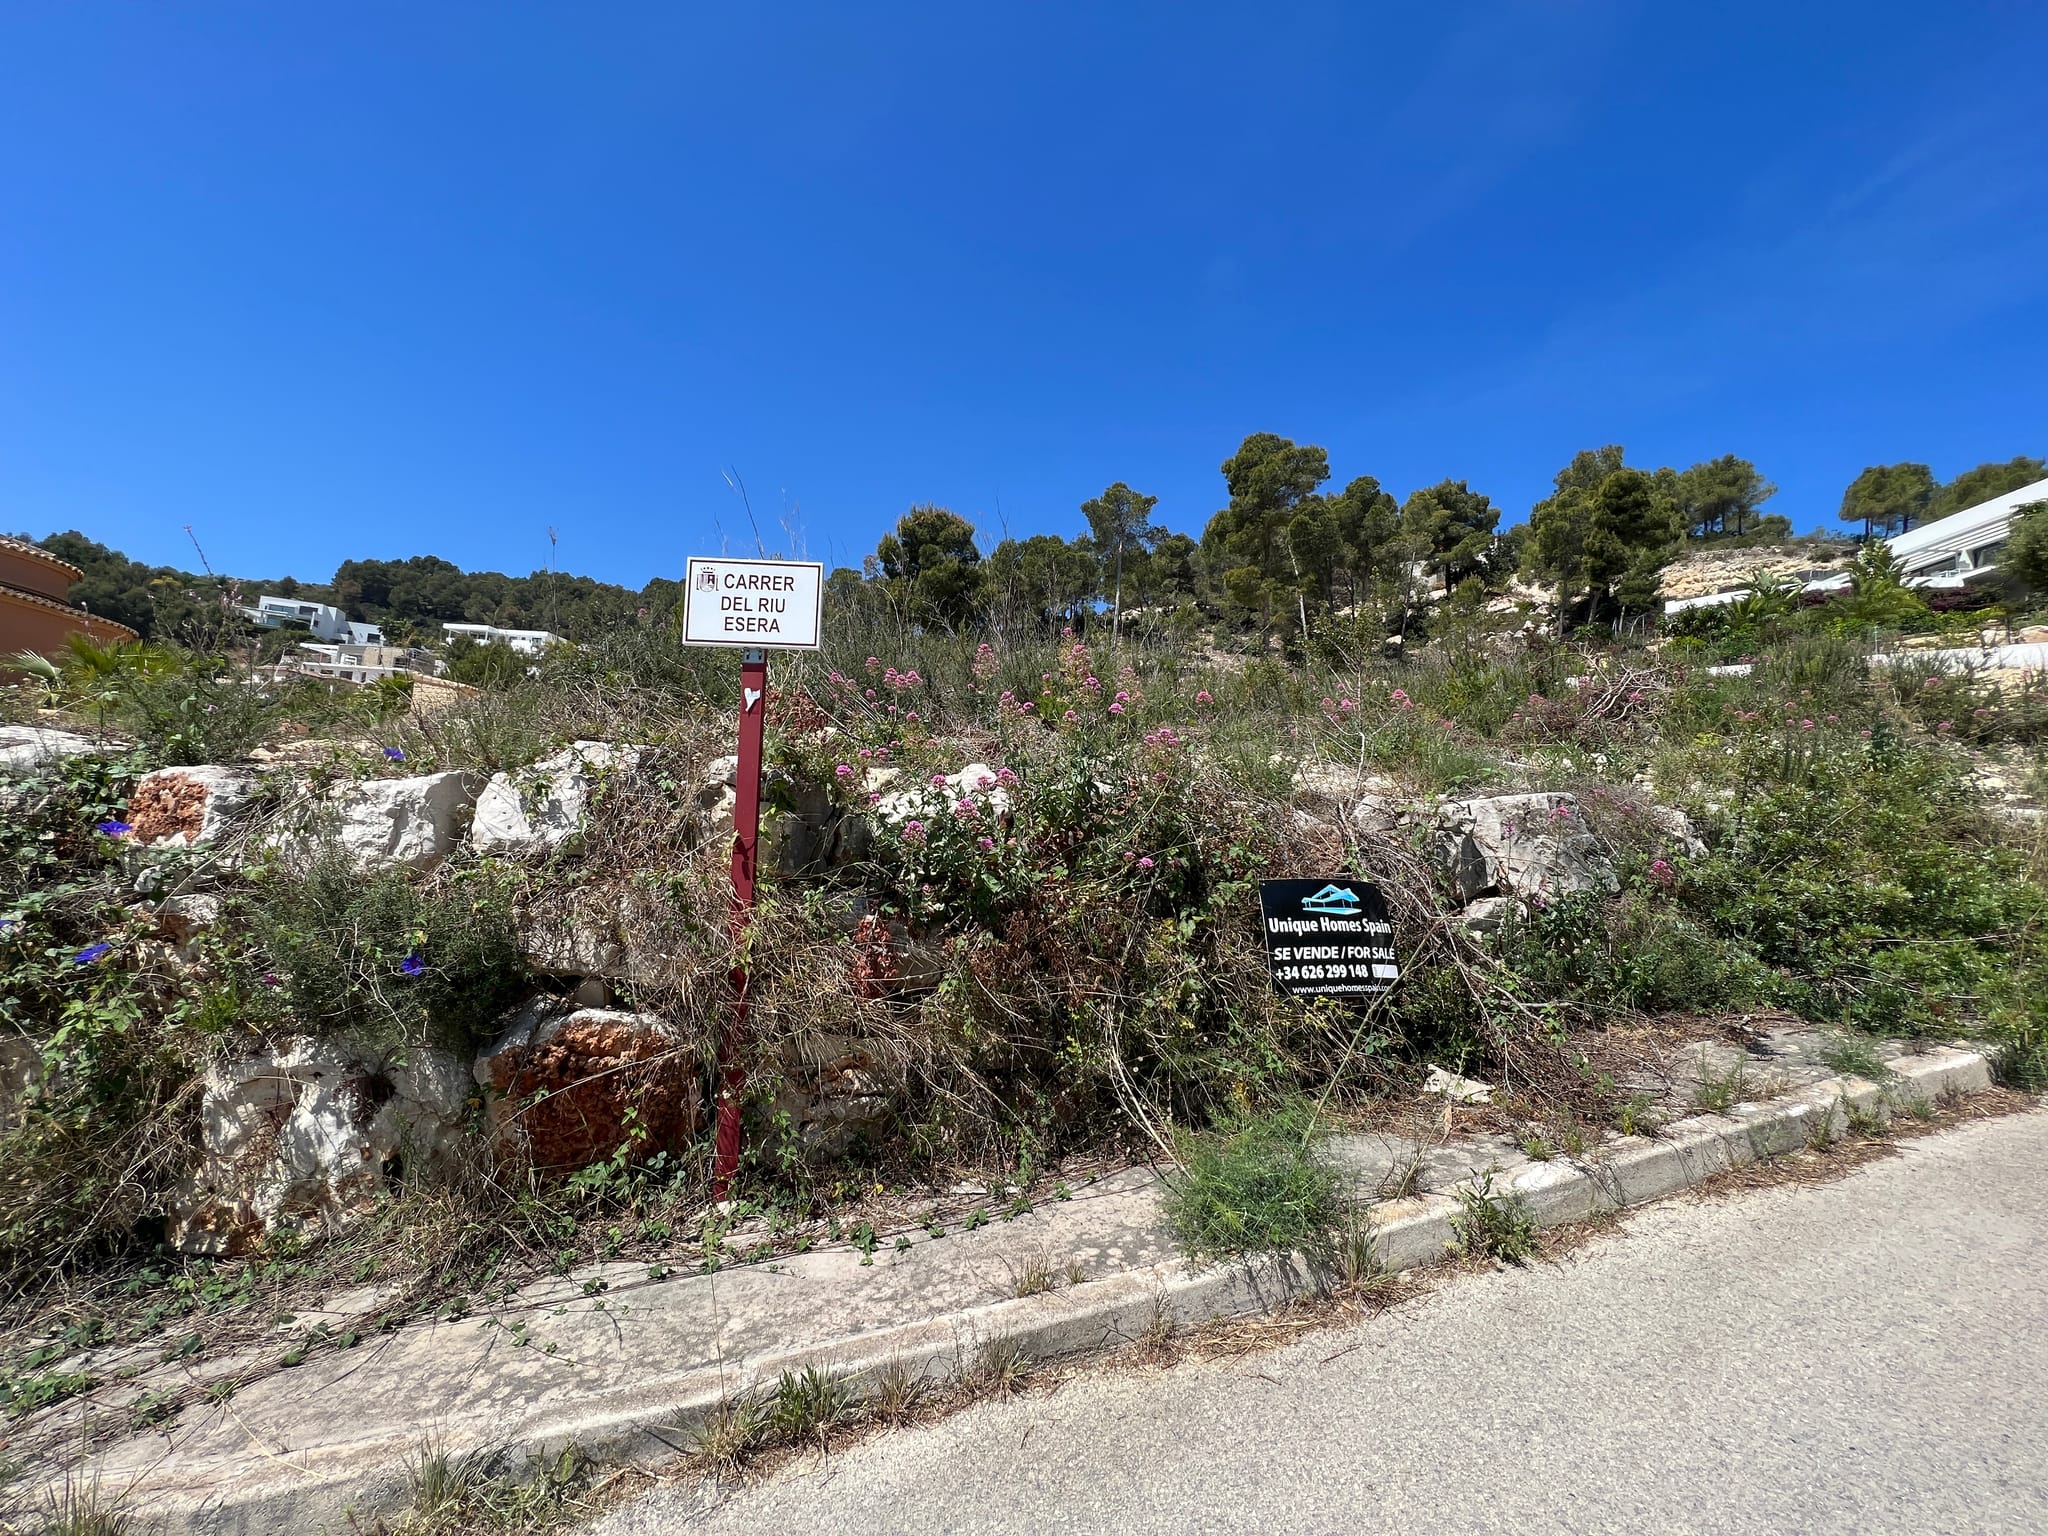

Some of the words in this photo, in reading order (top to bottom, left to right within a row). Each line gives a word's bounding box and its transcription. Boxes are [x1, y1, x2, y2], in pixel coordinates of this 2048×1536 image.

[724, 573, 795, 591] CARRER
[721, 596, 753, 612] DEL
[758, 598, 786, 613] RIU
[724, 616, 780, 633] ESERA
[1268, 917, 1319, 936] Unique
[1319, 917, 1361, 932] Homes
[1362, 918, 1392, 936] Spain
[1274, 947, 1291, 960] SE
[1293, 946, 1339, 960] VENDE
[1341, 946, 1346, 959] /
[1347, 946, 1371, 959] FOR
[1372, 947, 1395, 960] SALE
[1275, 966, 1300, 980] +34
[1301, 965, 1324, 979] 626
[1325, 964, 1347, 978] 299
[1348, 964, 1369, 978] 148
